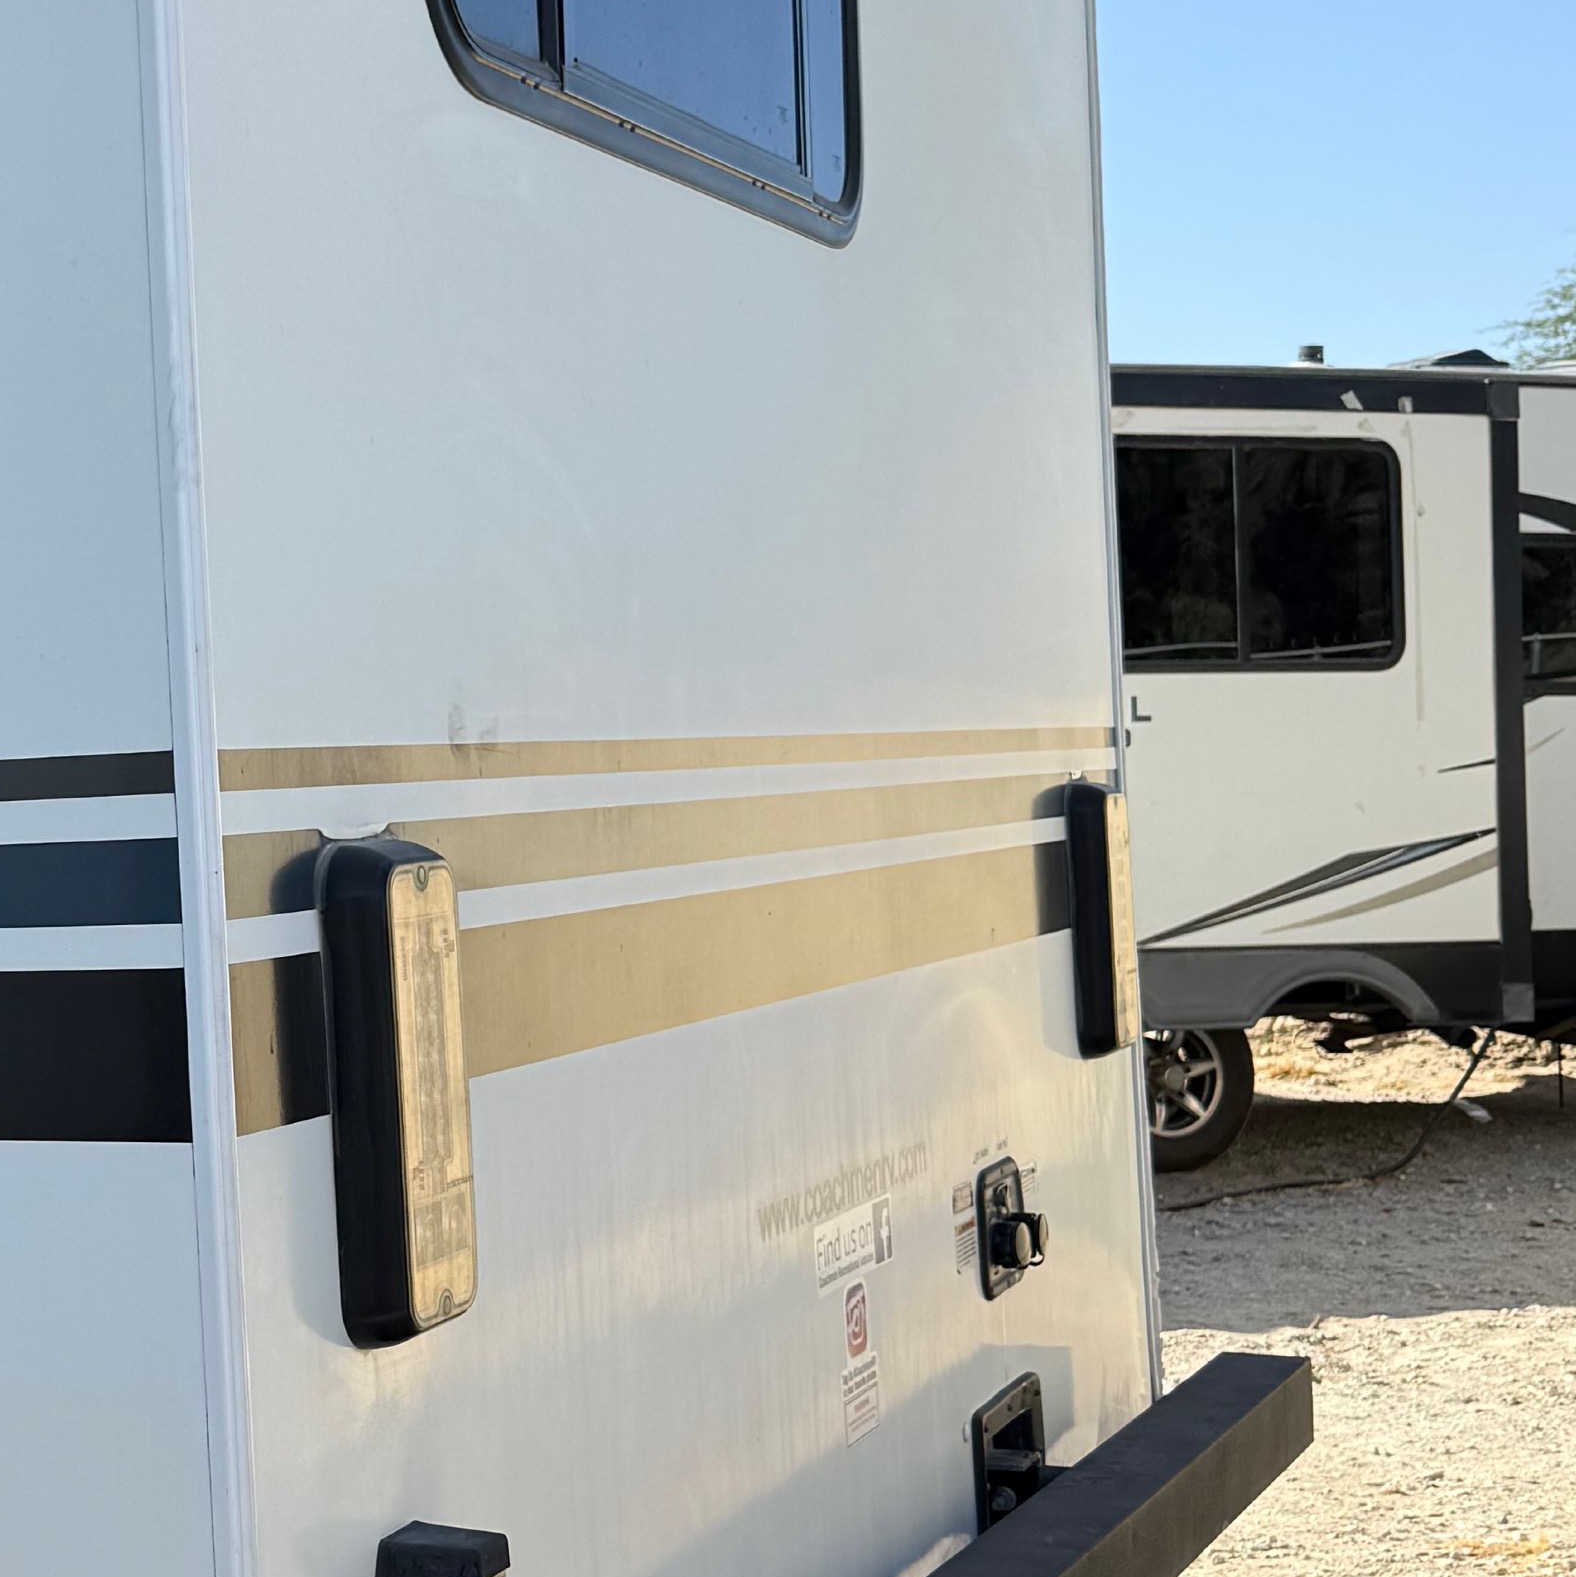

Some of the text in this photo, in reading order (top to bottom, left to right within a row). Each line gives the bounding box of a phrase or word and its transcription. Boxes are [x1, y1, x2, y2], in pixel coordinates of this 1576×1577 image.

[757, 1141, 927, 1243] www.coachmenrv.com
[816, 1226, 842, 1271] Find
[844, 1228, 857, 1256] us
[859, 1221, 873, 1250] on
